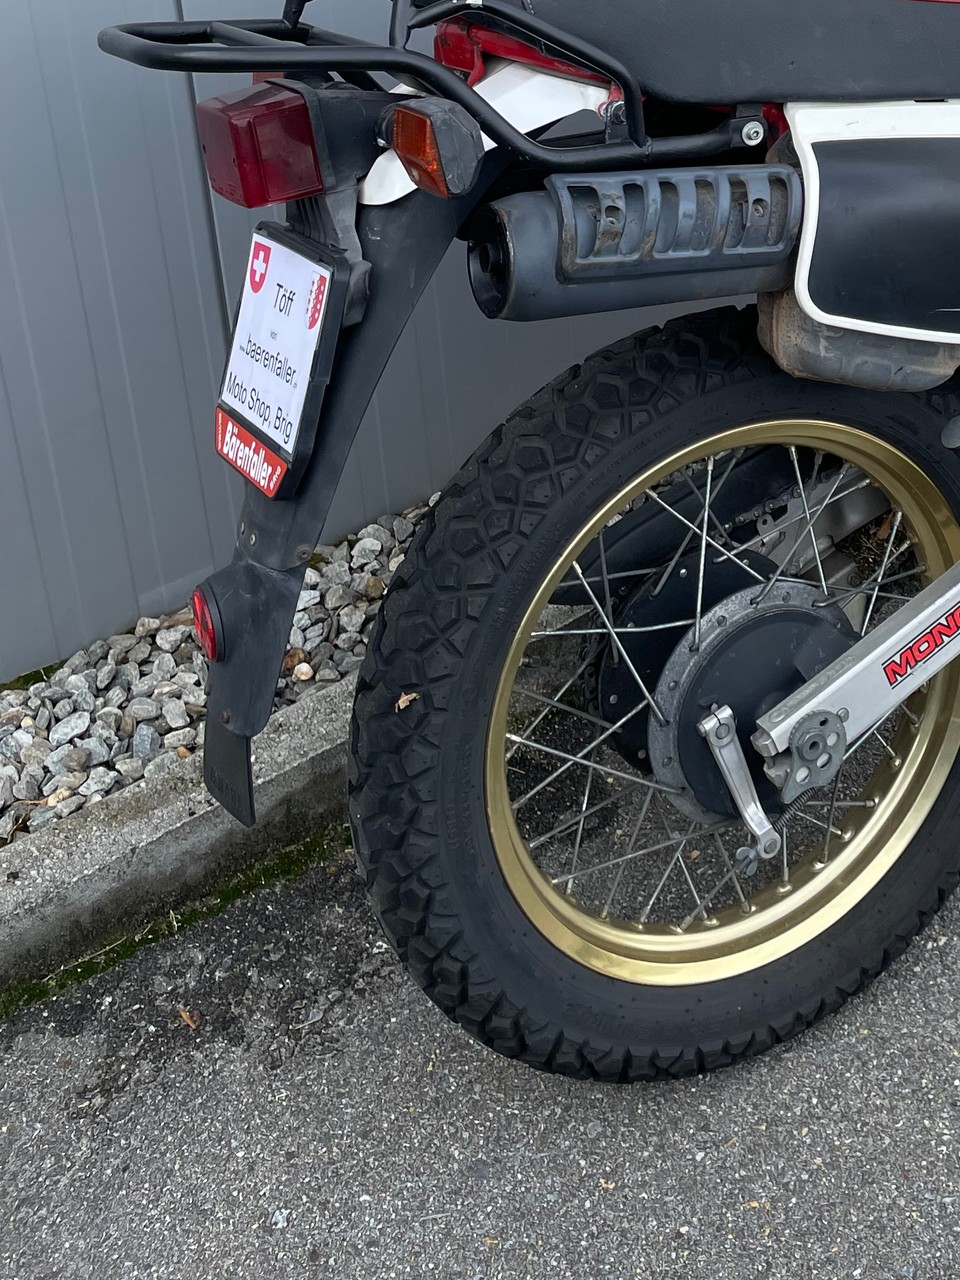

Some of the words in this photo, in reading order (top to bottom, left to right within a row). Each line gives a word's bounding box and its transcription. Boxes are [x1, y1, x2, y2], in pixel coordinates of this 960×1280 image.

[274, 283, 296, 317] Töff
[226, 371, 248, 405] Moto
[248, 388, 271, 429] Shop,
[274, 406, 293, 445] Brig
[223, 420, 271, 490] Bärenfaller
